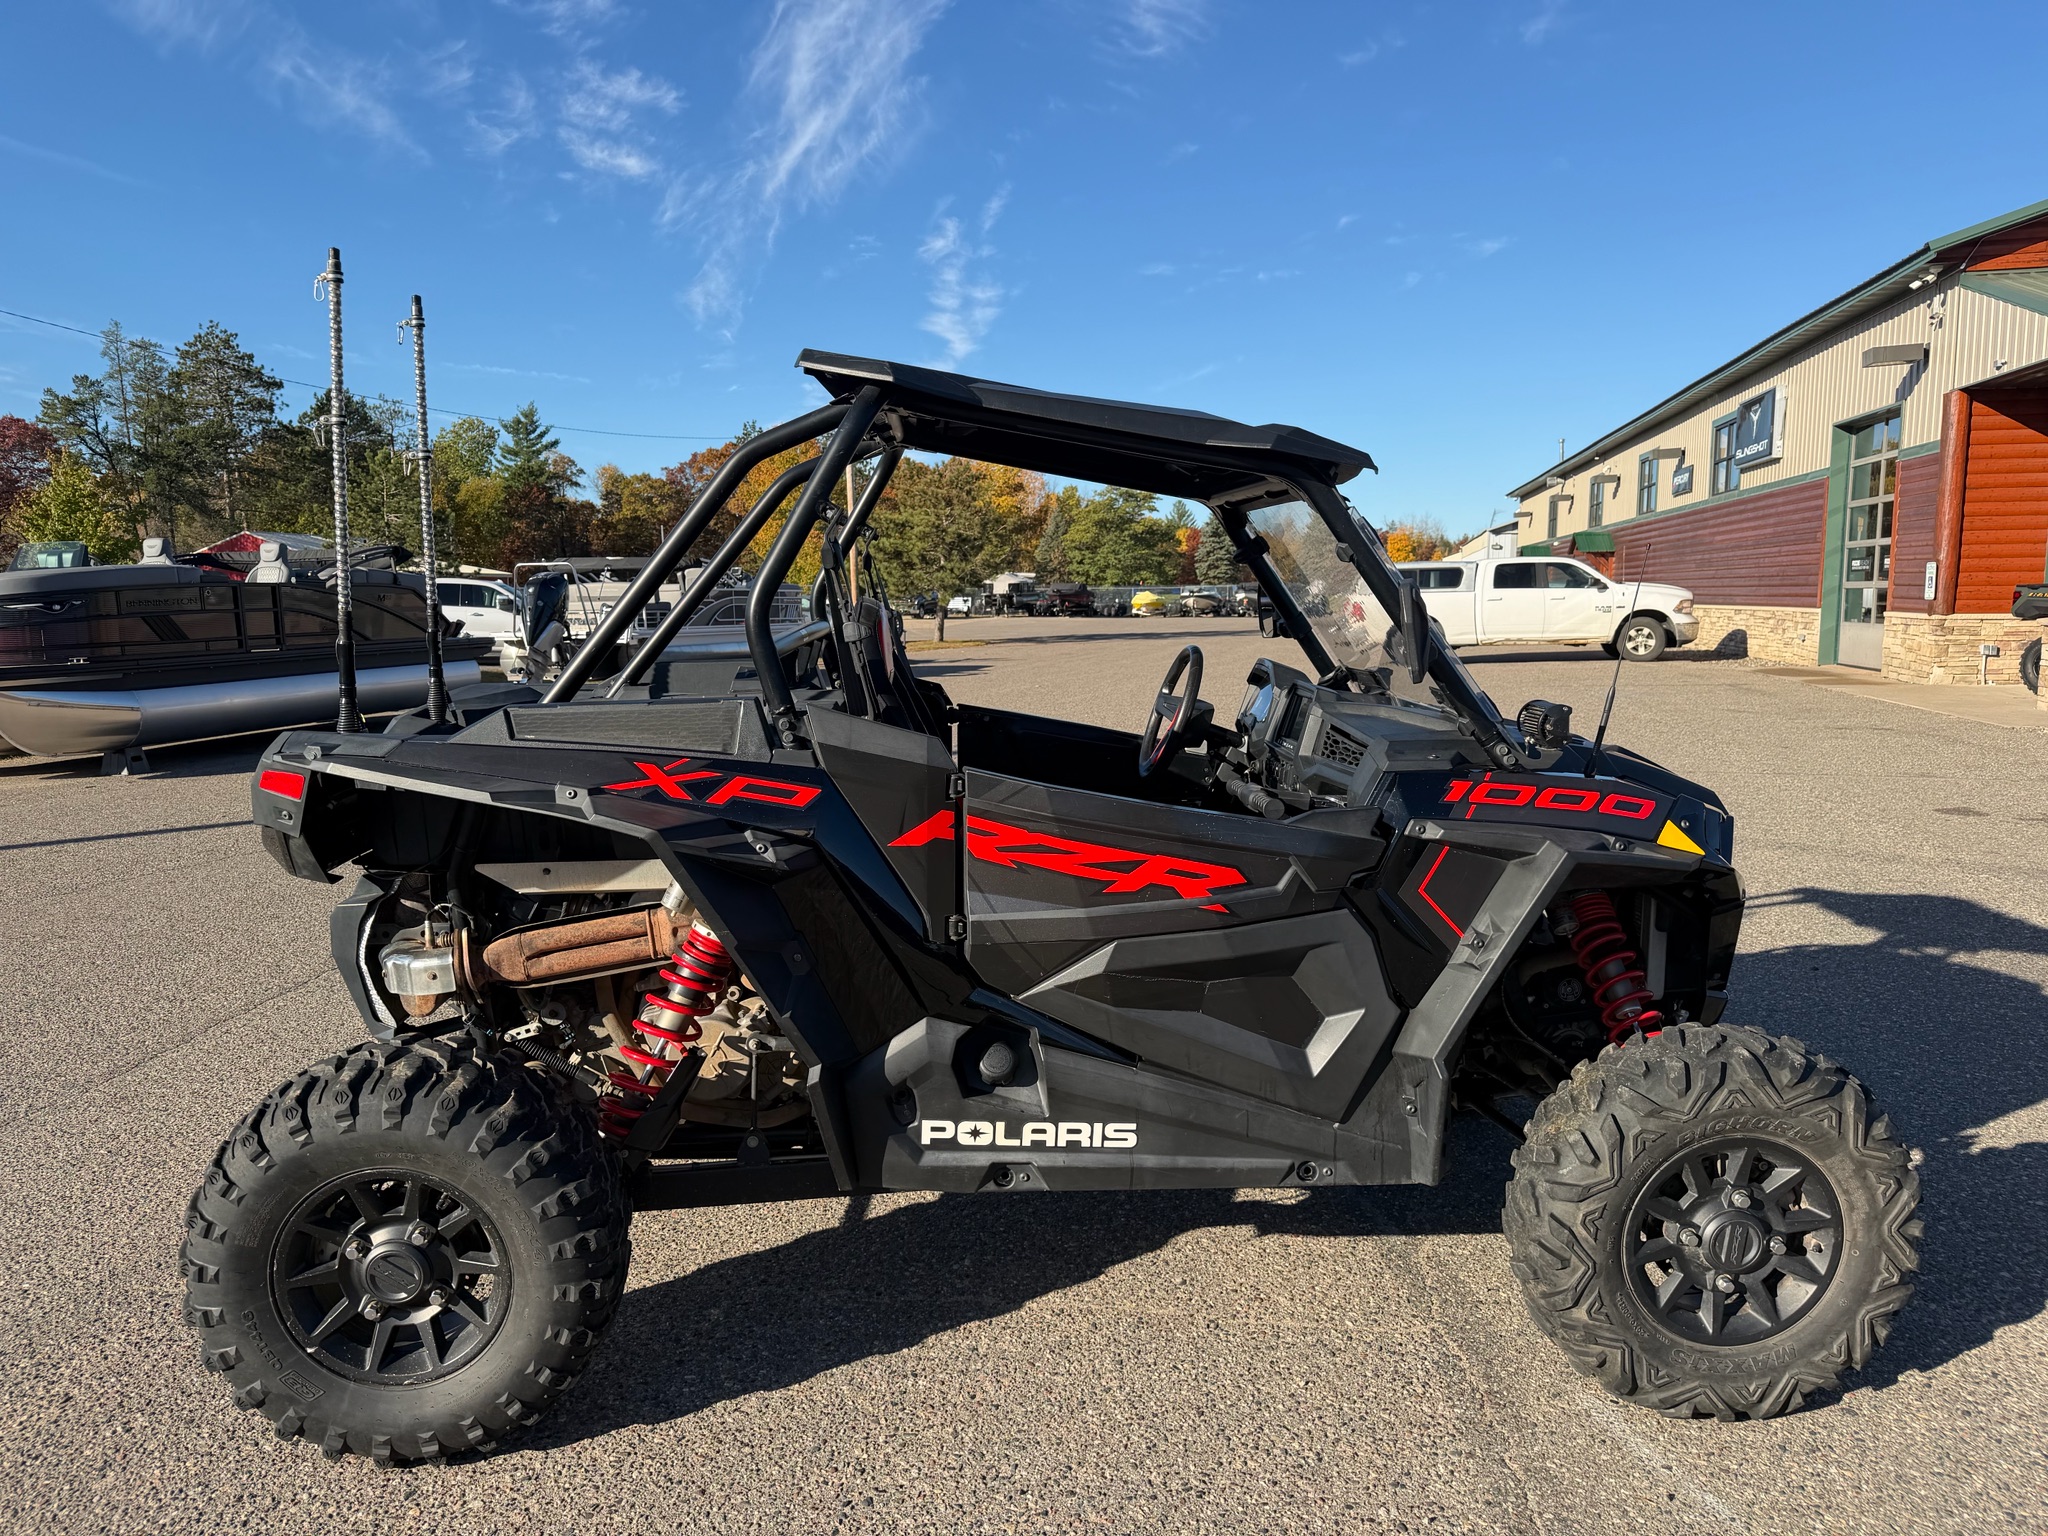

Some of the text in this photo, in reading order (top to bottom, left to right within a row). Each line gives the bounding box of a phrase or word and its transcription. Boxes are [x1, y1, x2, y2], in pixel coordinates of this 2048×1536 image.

[1735, 439, 1768, 459] SLINGSHOT
[125, 597, 199, 608] BENNINGTON
[601, 758, 822, 808] XP
[1443, 772, 1656, 820] 1000
[887, 810, 1247, 913] RZR
[920, 1119, 1139, 1149] POLARIS
[1676, 1114, 1817, 1149] BIGHORN
[241, 1310, 283, 1371] QBT446
[1668, 1342, 1798, 1375] MAXXIS
